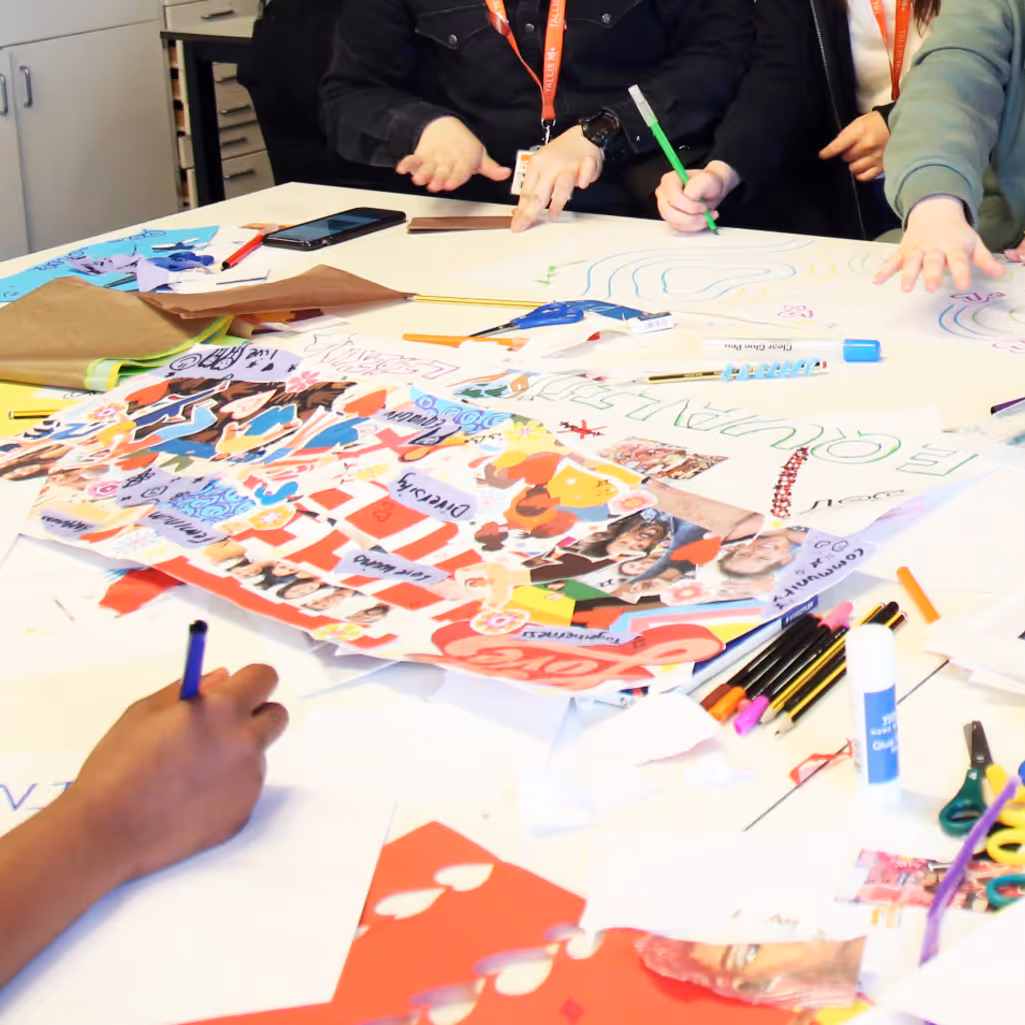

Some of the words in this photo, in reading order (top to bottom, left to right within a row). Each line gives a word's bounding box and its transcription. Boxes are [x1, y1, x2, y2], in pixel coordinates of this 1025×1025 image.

[547, 47, 556, 62] 16+
[545, 61, 556, 93] TALLIS
[767, 343, 793, 352] Clear
[396, 472, 470, 519] Diversity
